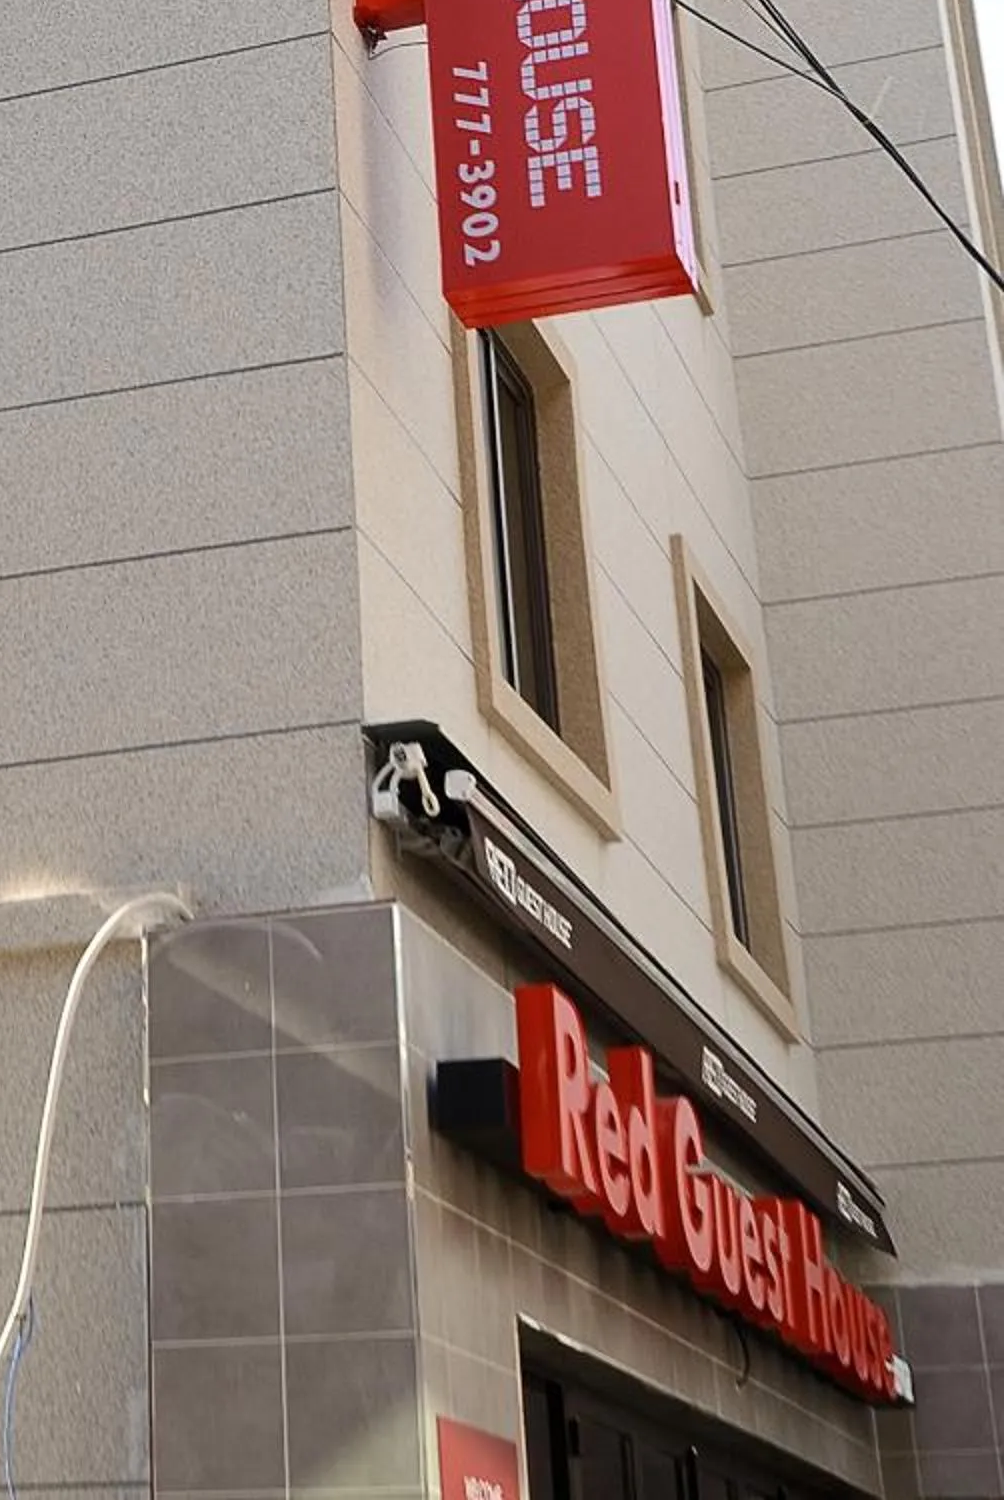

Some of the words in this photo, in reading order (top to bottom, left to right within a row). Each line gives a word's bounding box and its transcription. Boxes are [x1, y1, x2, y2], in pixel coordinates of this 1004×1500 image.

[452, 61, 501, 267] 777-3902
[552, 986, 666, 1238] Red
[674, 1095, 794, 1328] Guest
[797, 1201, 897, 1399] House
